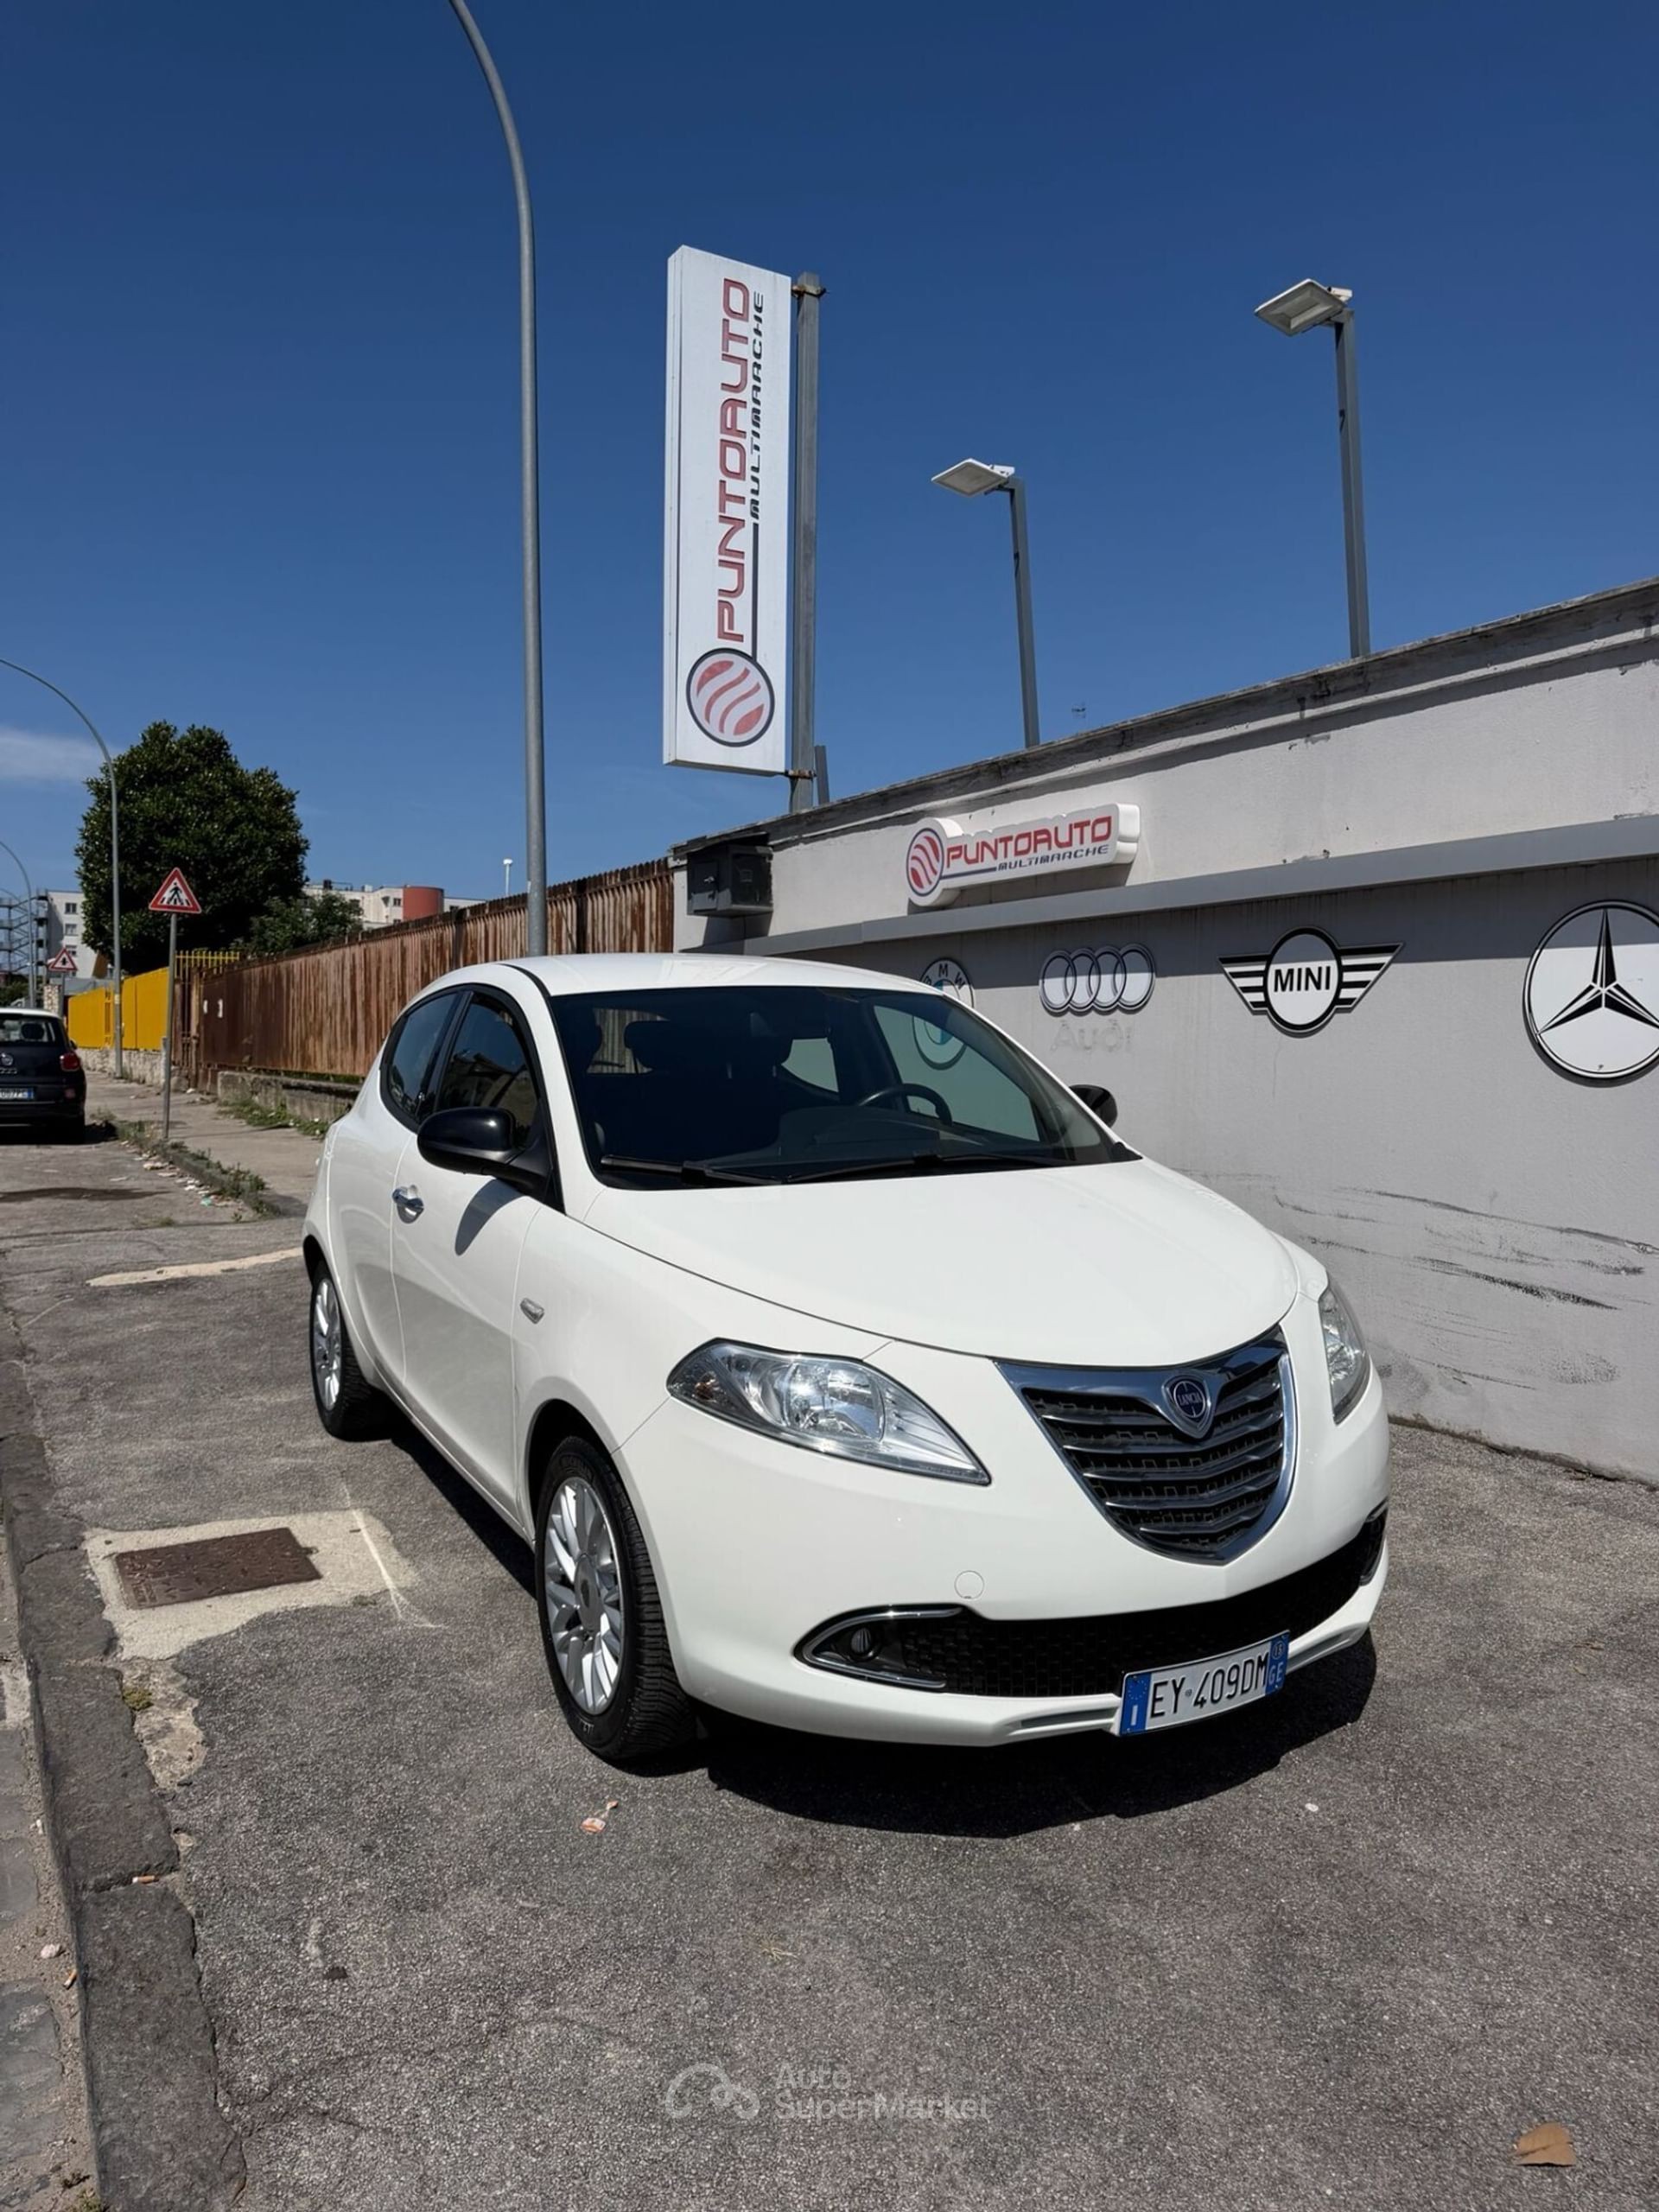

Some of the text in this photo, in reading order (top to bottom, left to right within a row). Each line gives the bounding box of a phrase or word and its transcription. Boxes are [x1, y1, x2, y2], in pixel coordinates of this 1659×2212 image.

[749, 290, 764, 520] MULTIMARCHE
[717, 277, 750, 642] PUNTOAUTO
[947, 816, 1112, 868] PUNTOAUTO
[997, 844, 1109, 872] MULTIMARCHE
[1274, 966, 1331, 992] MINI
[1150, 1677, 1185, 1719] EY
[1193, 1651, 1269, 1708] 409DM
[1268, 1662, 1284, 1685] GE
